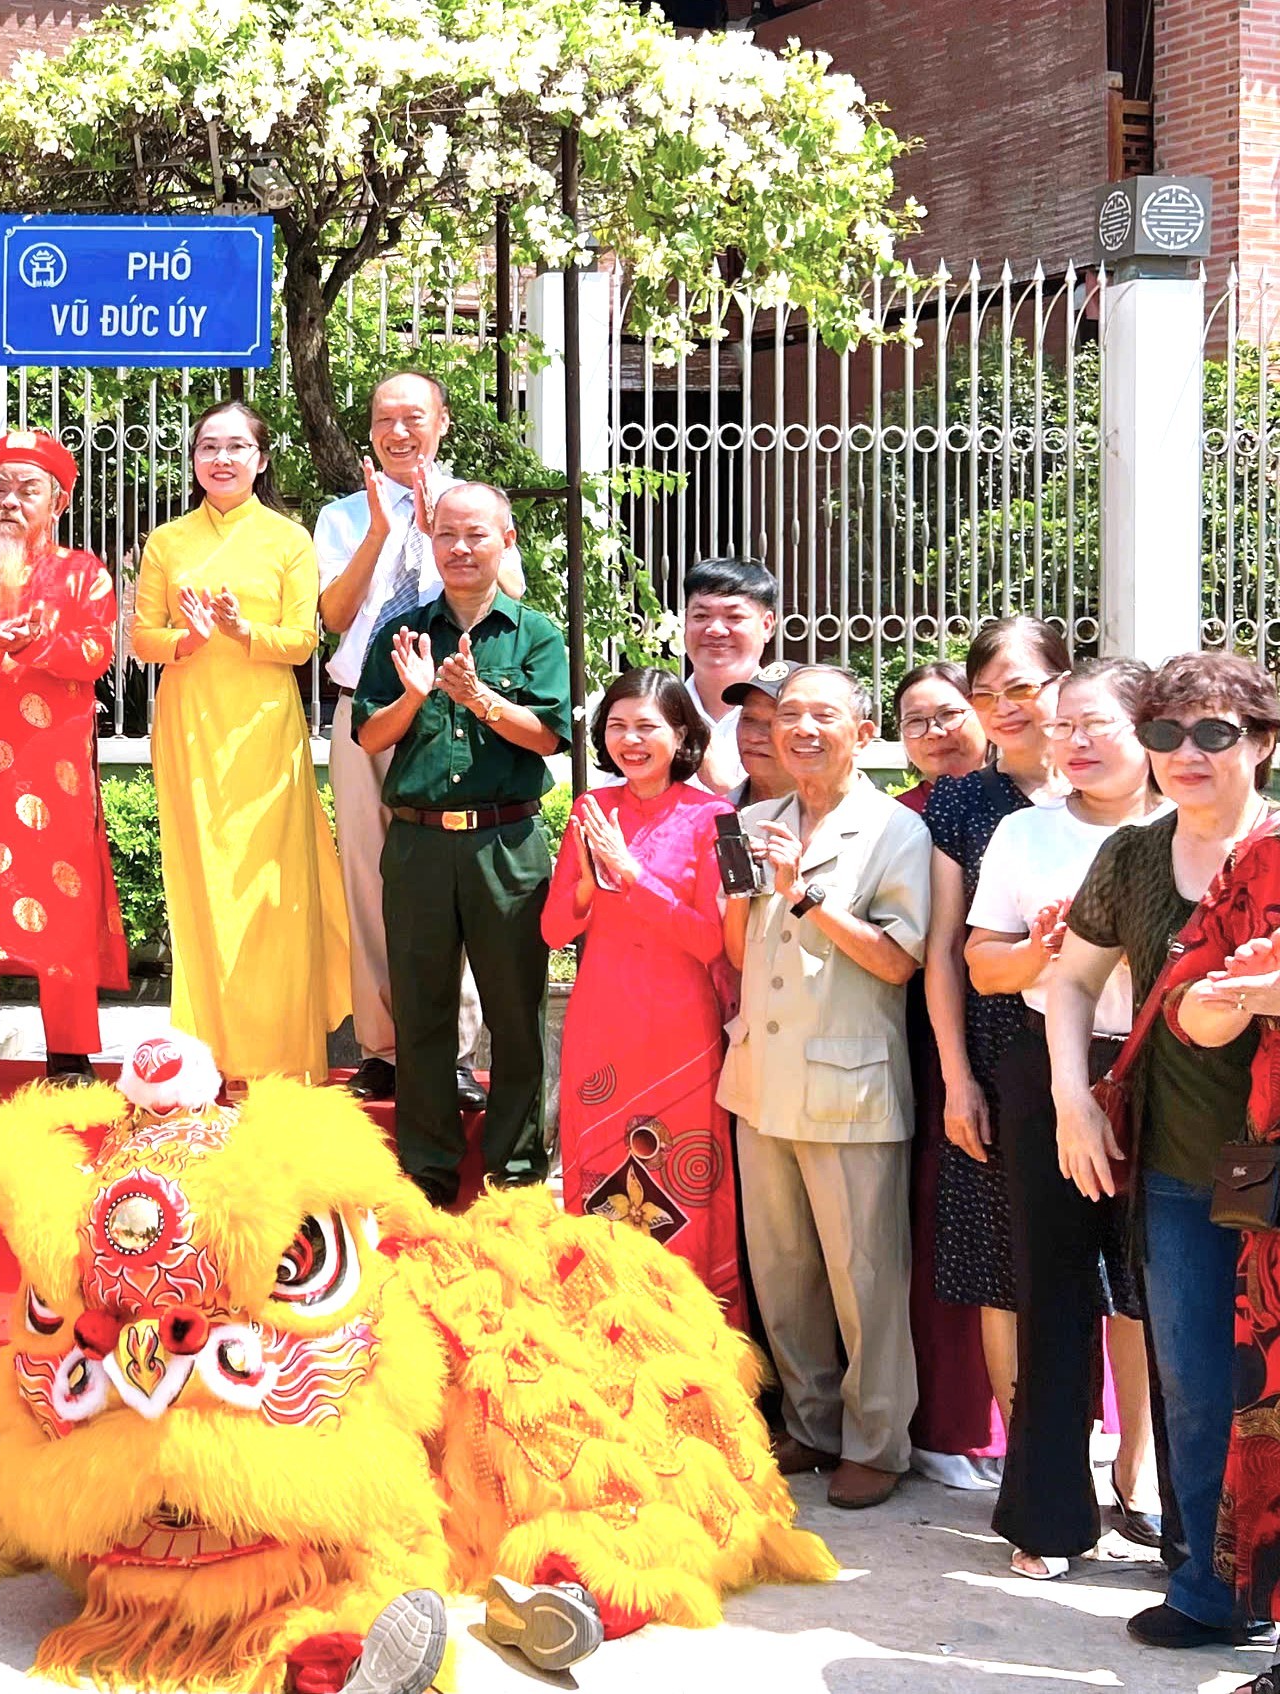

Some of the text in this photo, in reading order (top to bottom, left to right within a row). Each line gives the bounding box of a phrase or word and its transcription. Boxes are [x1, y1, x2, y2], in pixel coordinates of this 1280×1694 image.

[128, 240, 191, 280] PHỐ
[51, 294, 207, 337] VŨ ĐỨC ÚY
